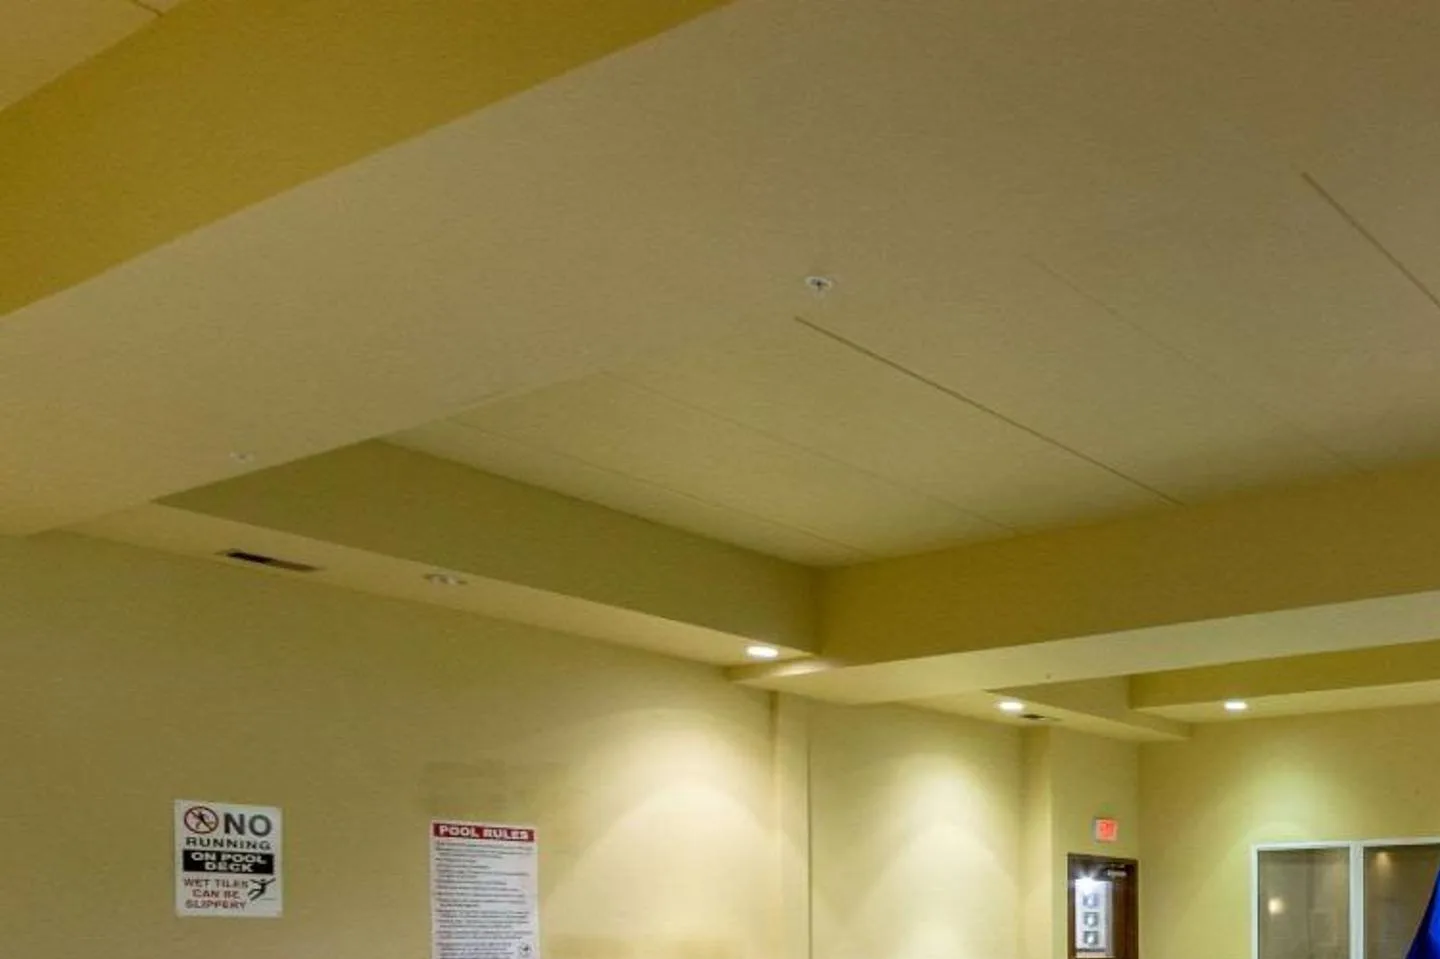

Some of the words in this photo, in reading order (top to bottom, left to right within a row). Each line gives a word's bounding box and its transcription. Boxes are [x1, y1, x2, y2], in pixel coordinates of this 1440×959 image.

[224, 813, 272, 837] NO
[439, 825, 479, 838] POOL
[483, 828, 529, 840] RULES
[186, 837, 271, 850] RUNNING
[191, 852, 217, 862] ON
[221, 853, 267, 864] POOL
[205, 862, 254, 873] DECK
[184, 878, 209, 888] WET
[216, 879, 249, 888] TILES
[192, 889, 219, 898] CAN
[224, 890, 241, 899] BE
[185, 899, 247, 909] SLIPPERY
